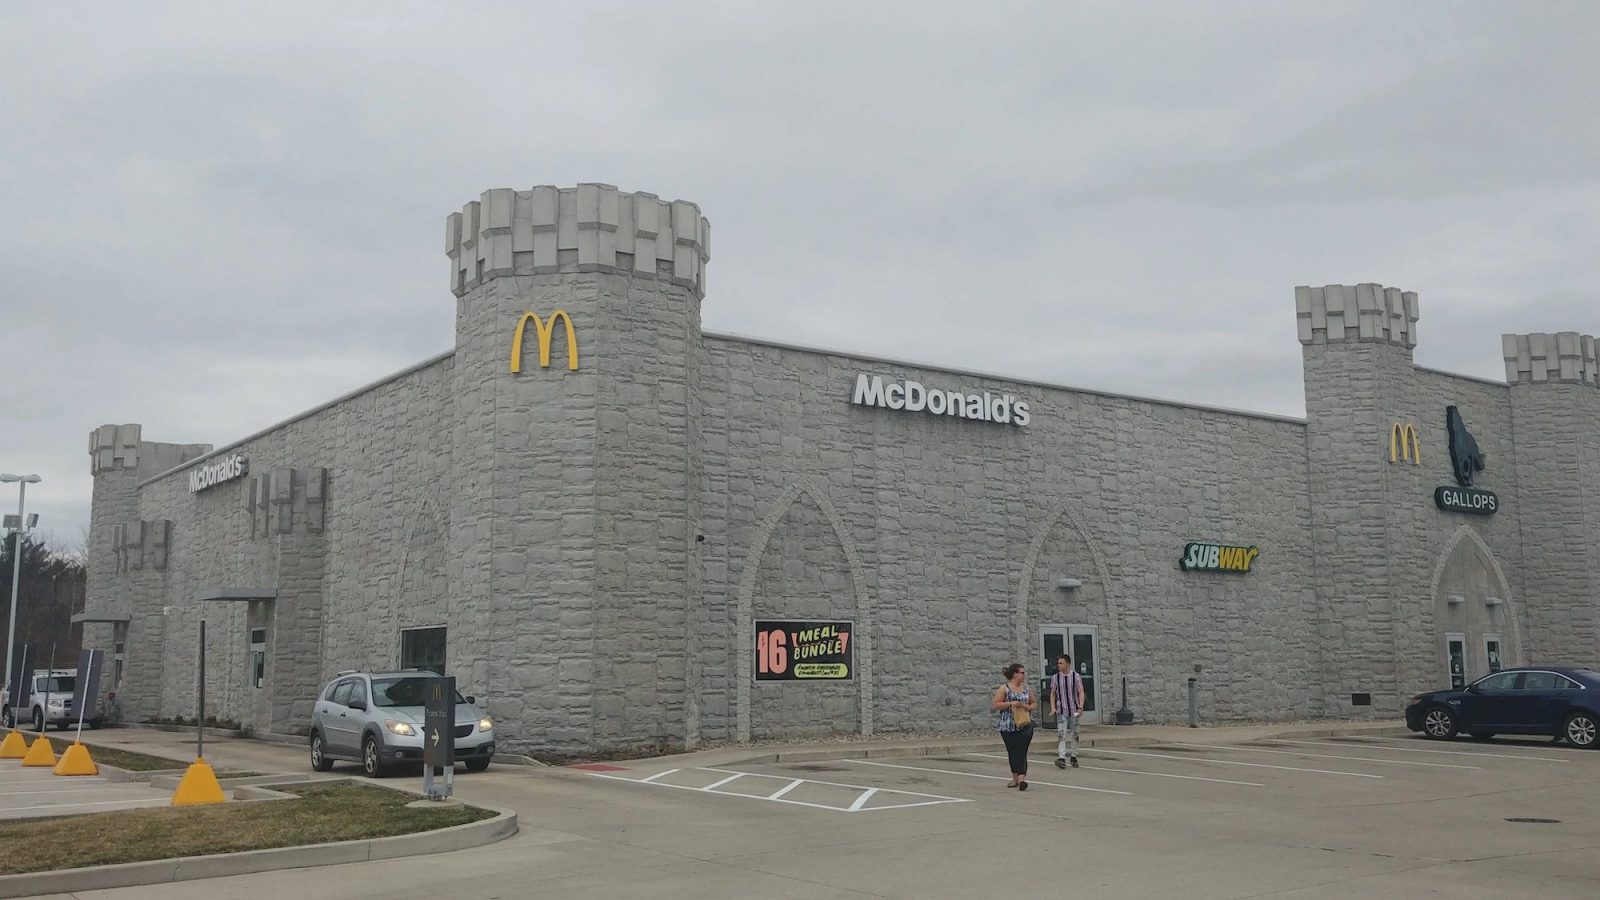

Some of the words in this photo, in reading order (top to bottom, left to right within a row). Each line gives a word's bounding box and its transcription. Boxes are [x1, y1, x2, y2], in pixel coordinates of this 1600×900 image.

[853, 373, 1031, 426] McDonald's
[189, 454, 242, 493] McDonald's
[1443, 490, 1496, 510] GALLOPS
[1184, 544, 1259, 570] SUBWAY
[799, 624, 838, 643] MEAL
[757, 629, 787, 674] 16
[793, 640, 842, 660] BUNDLE
